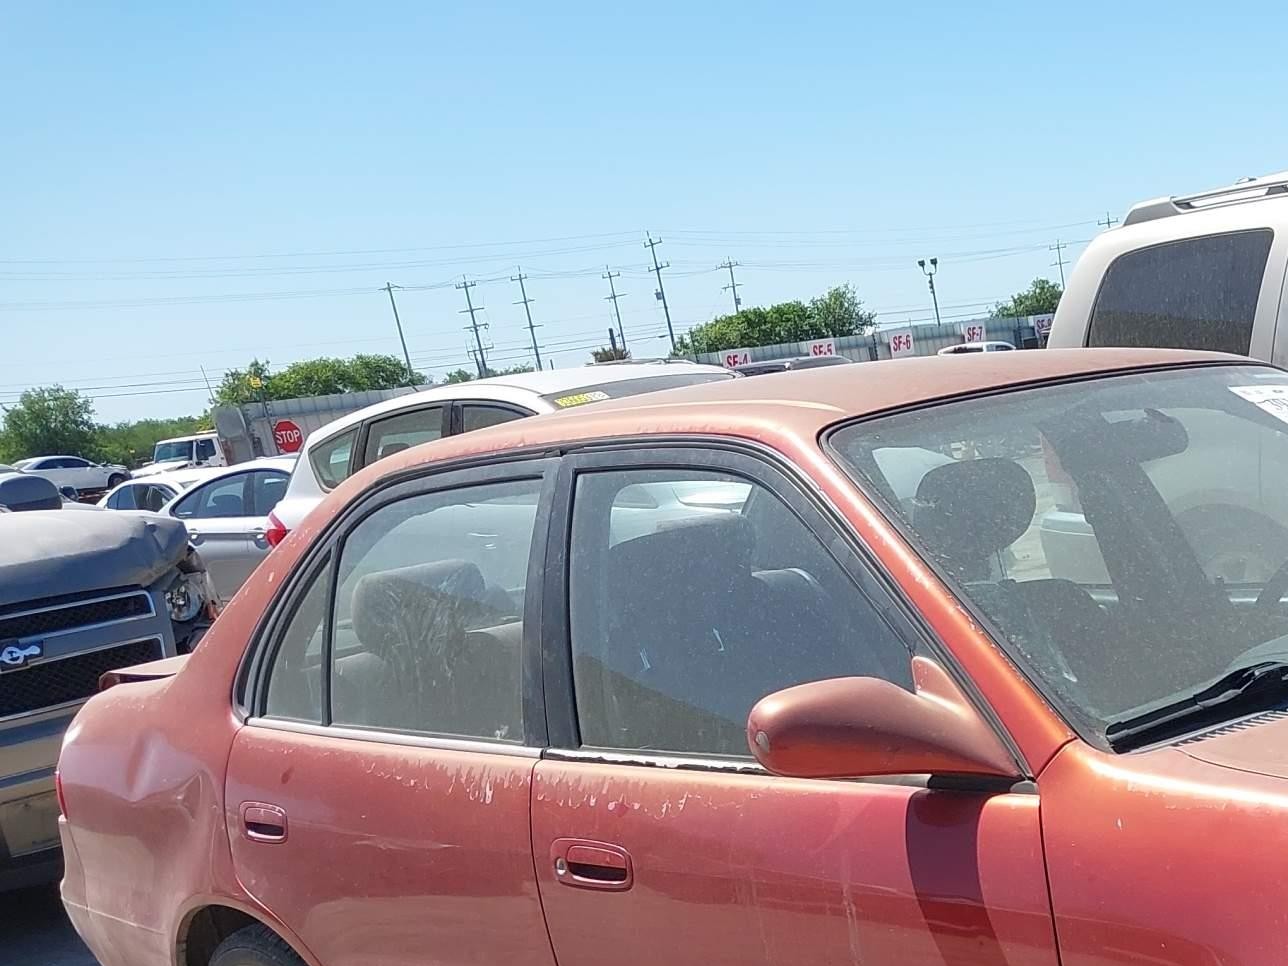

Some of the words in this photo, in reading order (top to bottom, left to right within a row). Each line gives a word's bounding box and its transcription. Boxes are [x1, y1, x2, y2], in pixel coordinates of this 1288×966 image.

[966, 325, 986, 342] SF-7
[892, 333, 912, 353] SF-6
[726, 352, 750, 368] SF-4
[276, 429, 300, 444] STOP
